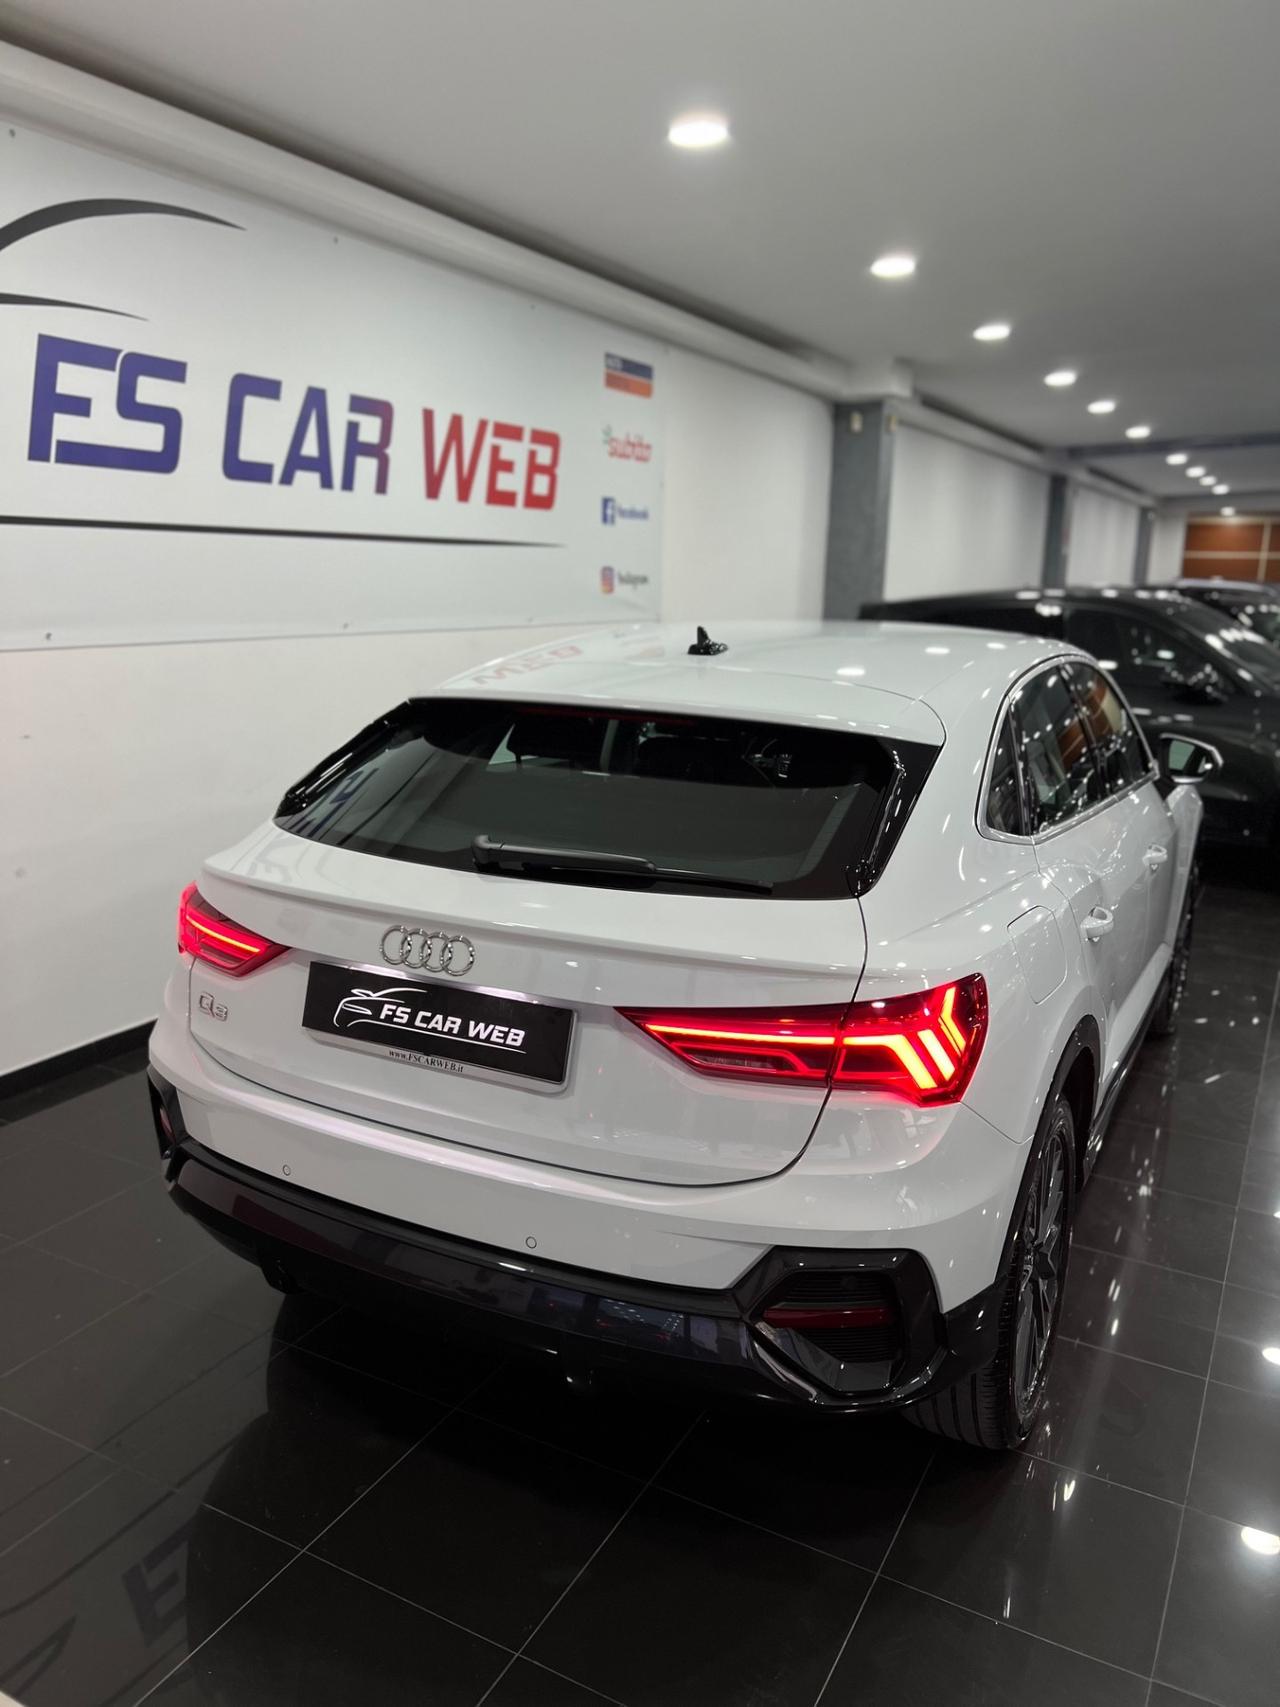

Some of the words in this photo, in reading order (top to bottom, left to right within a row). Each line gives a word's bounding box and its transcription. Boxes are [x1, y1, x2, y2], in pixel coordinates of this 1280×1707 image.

[27, 334, 188, 474] FS
[222, 373, 394, 495] CAR
[422, 409, 561, 511] WEB
[379, 1003, 411, 1024] FS
[414, 1010, 462, 1034] CAR
[468, 1020, 526, 1047] WEB
[389, 1050, 464, 1073] www.FSCARWEB.it
